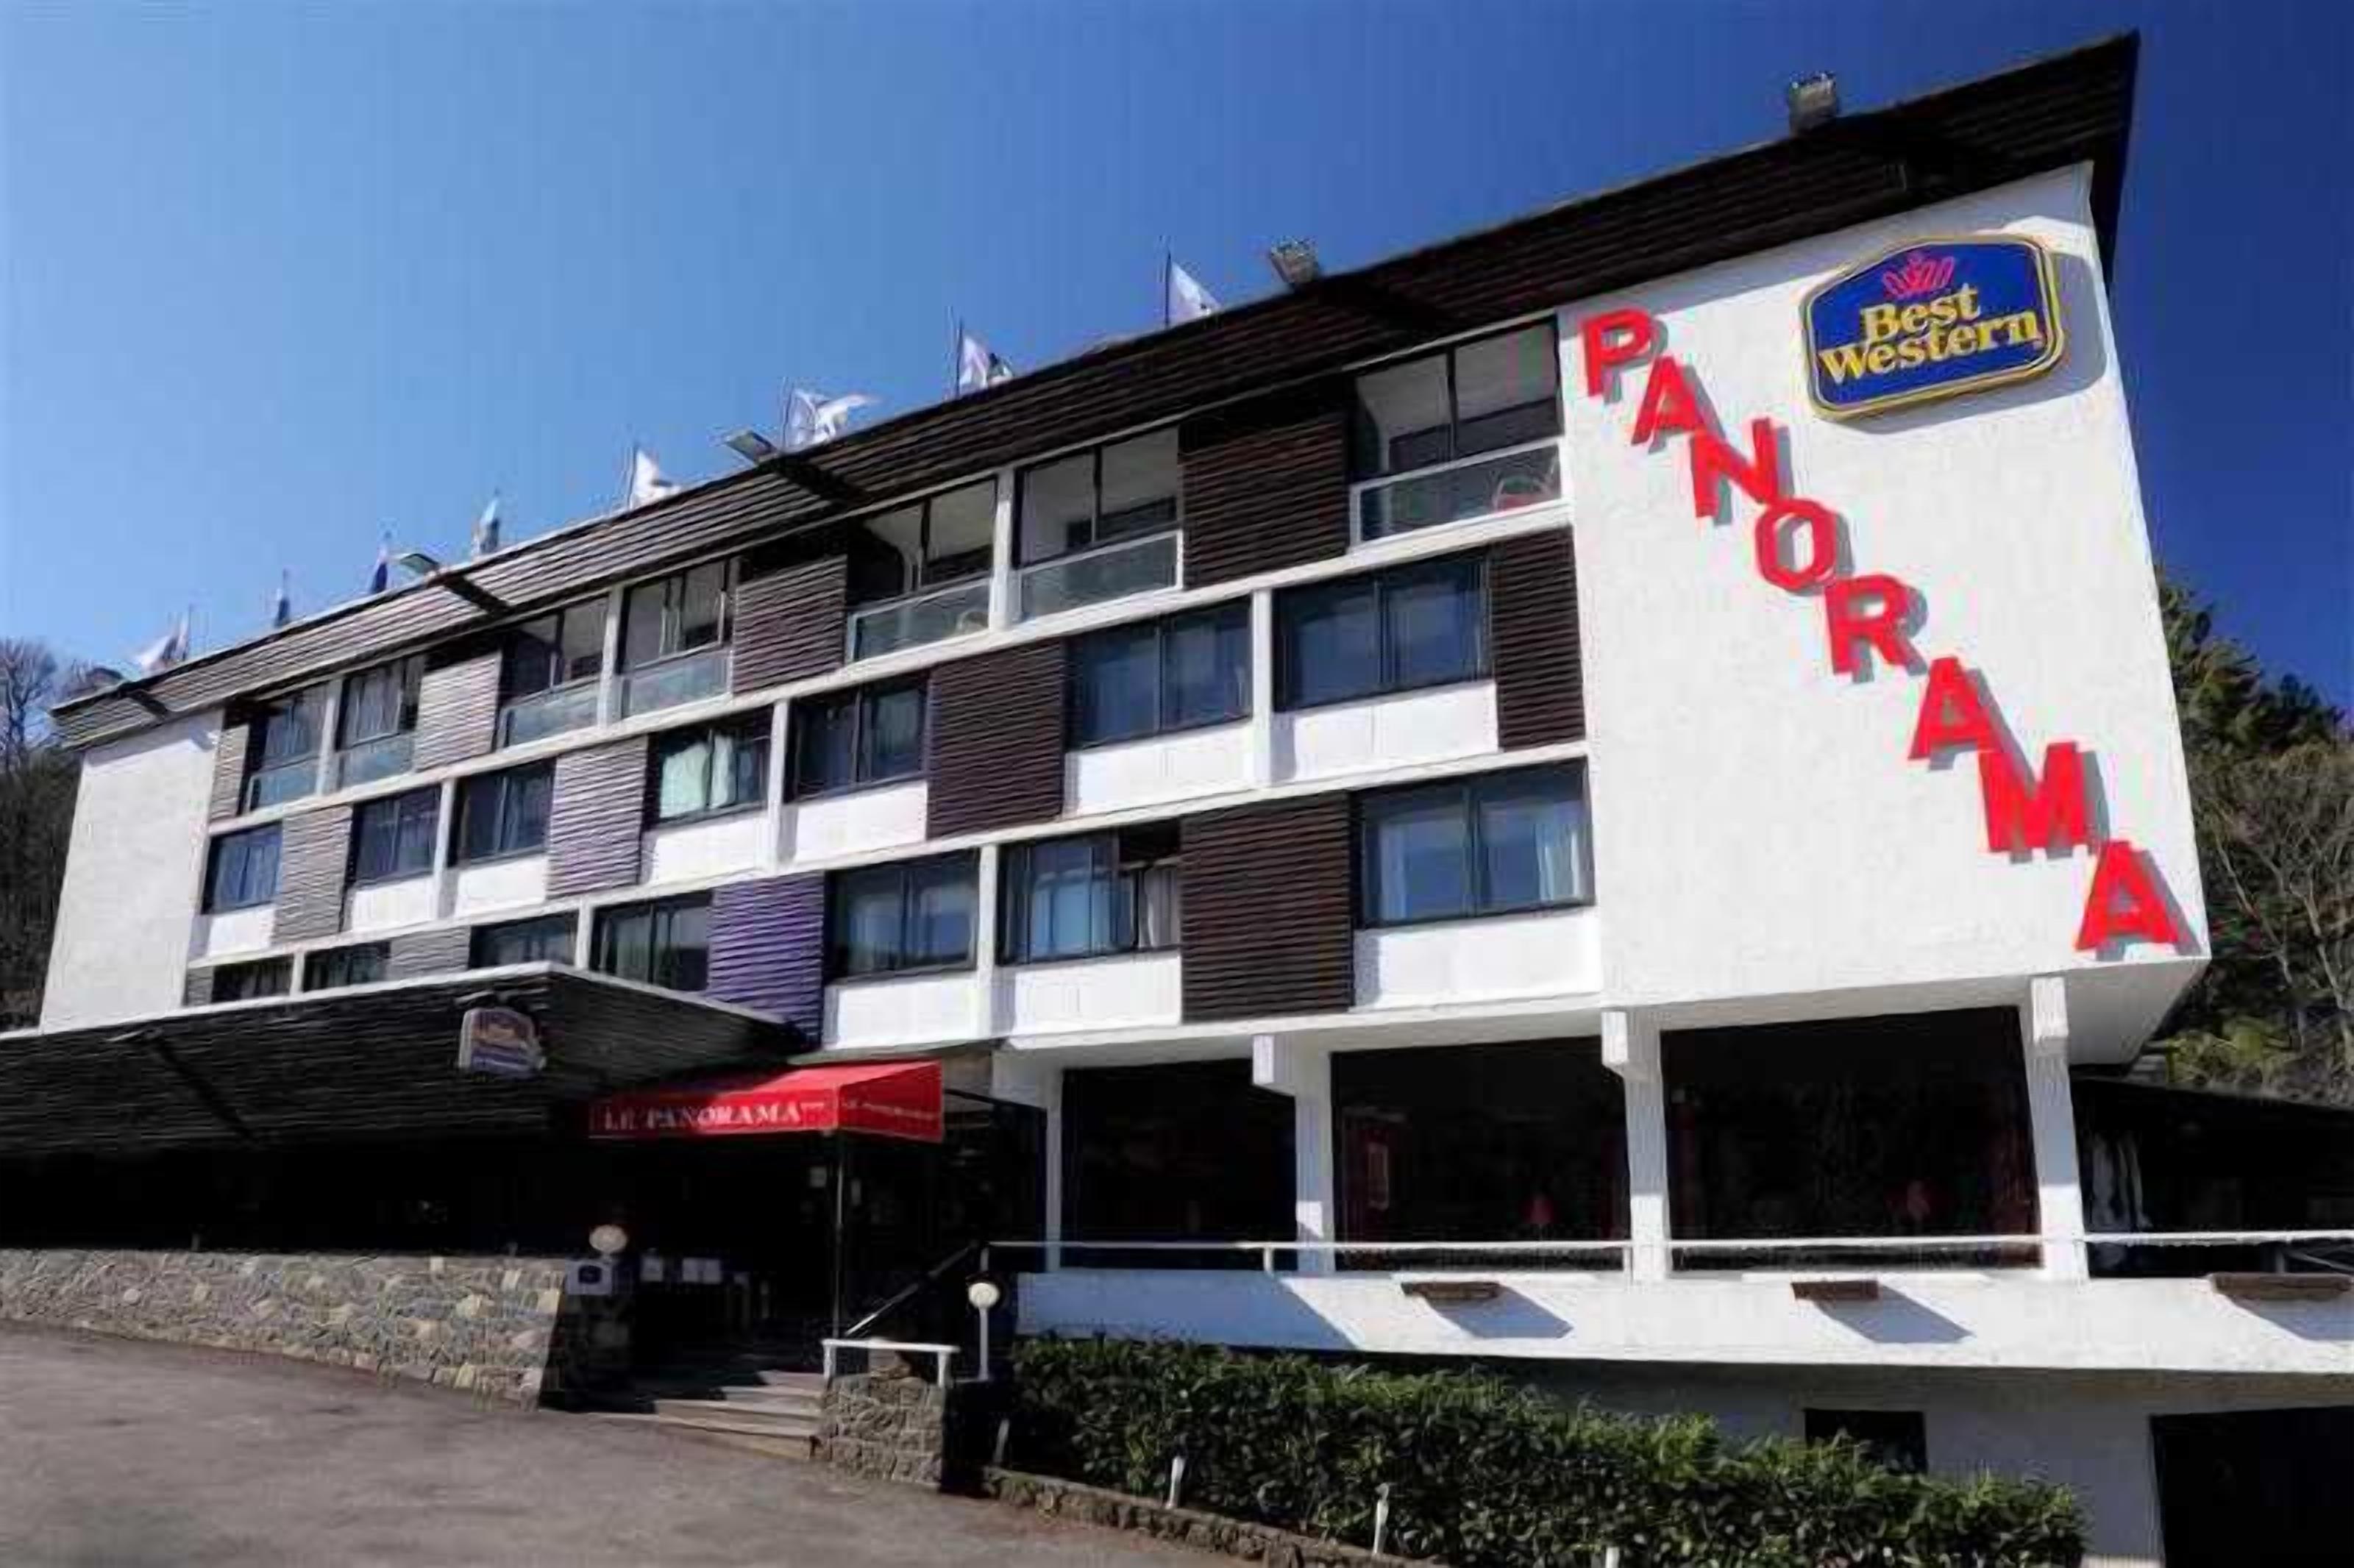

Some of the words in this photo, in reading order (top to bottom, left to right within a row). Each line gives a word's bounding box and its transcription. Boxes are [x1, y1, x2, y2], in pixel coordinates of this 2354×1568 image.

[1860, 282, 1982, 343] Best
[1818, 310, 2044, 384] Western
[1579, 308, 2182, 952] PANORAMA
[646, 1101, 802, 1129] PANORAMA
